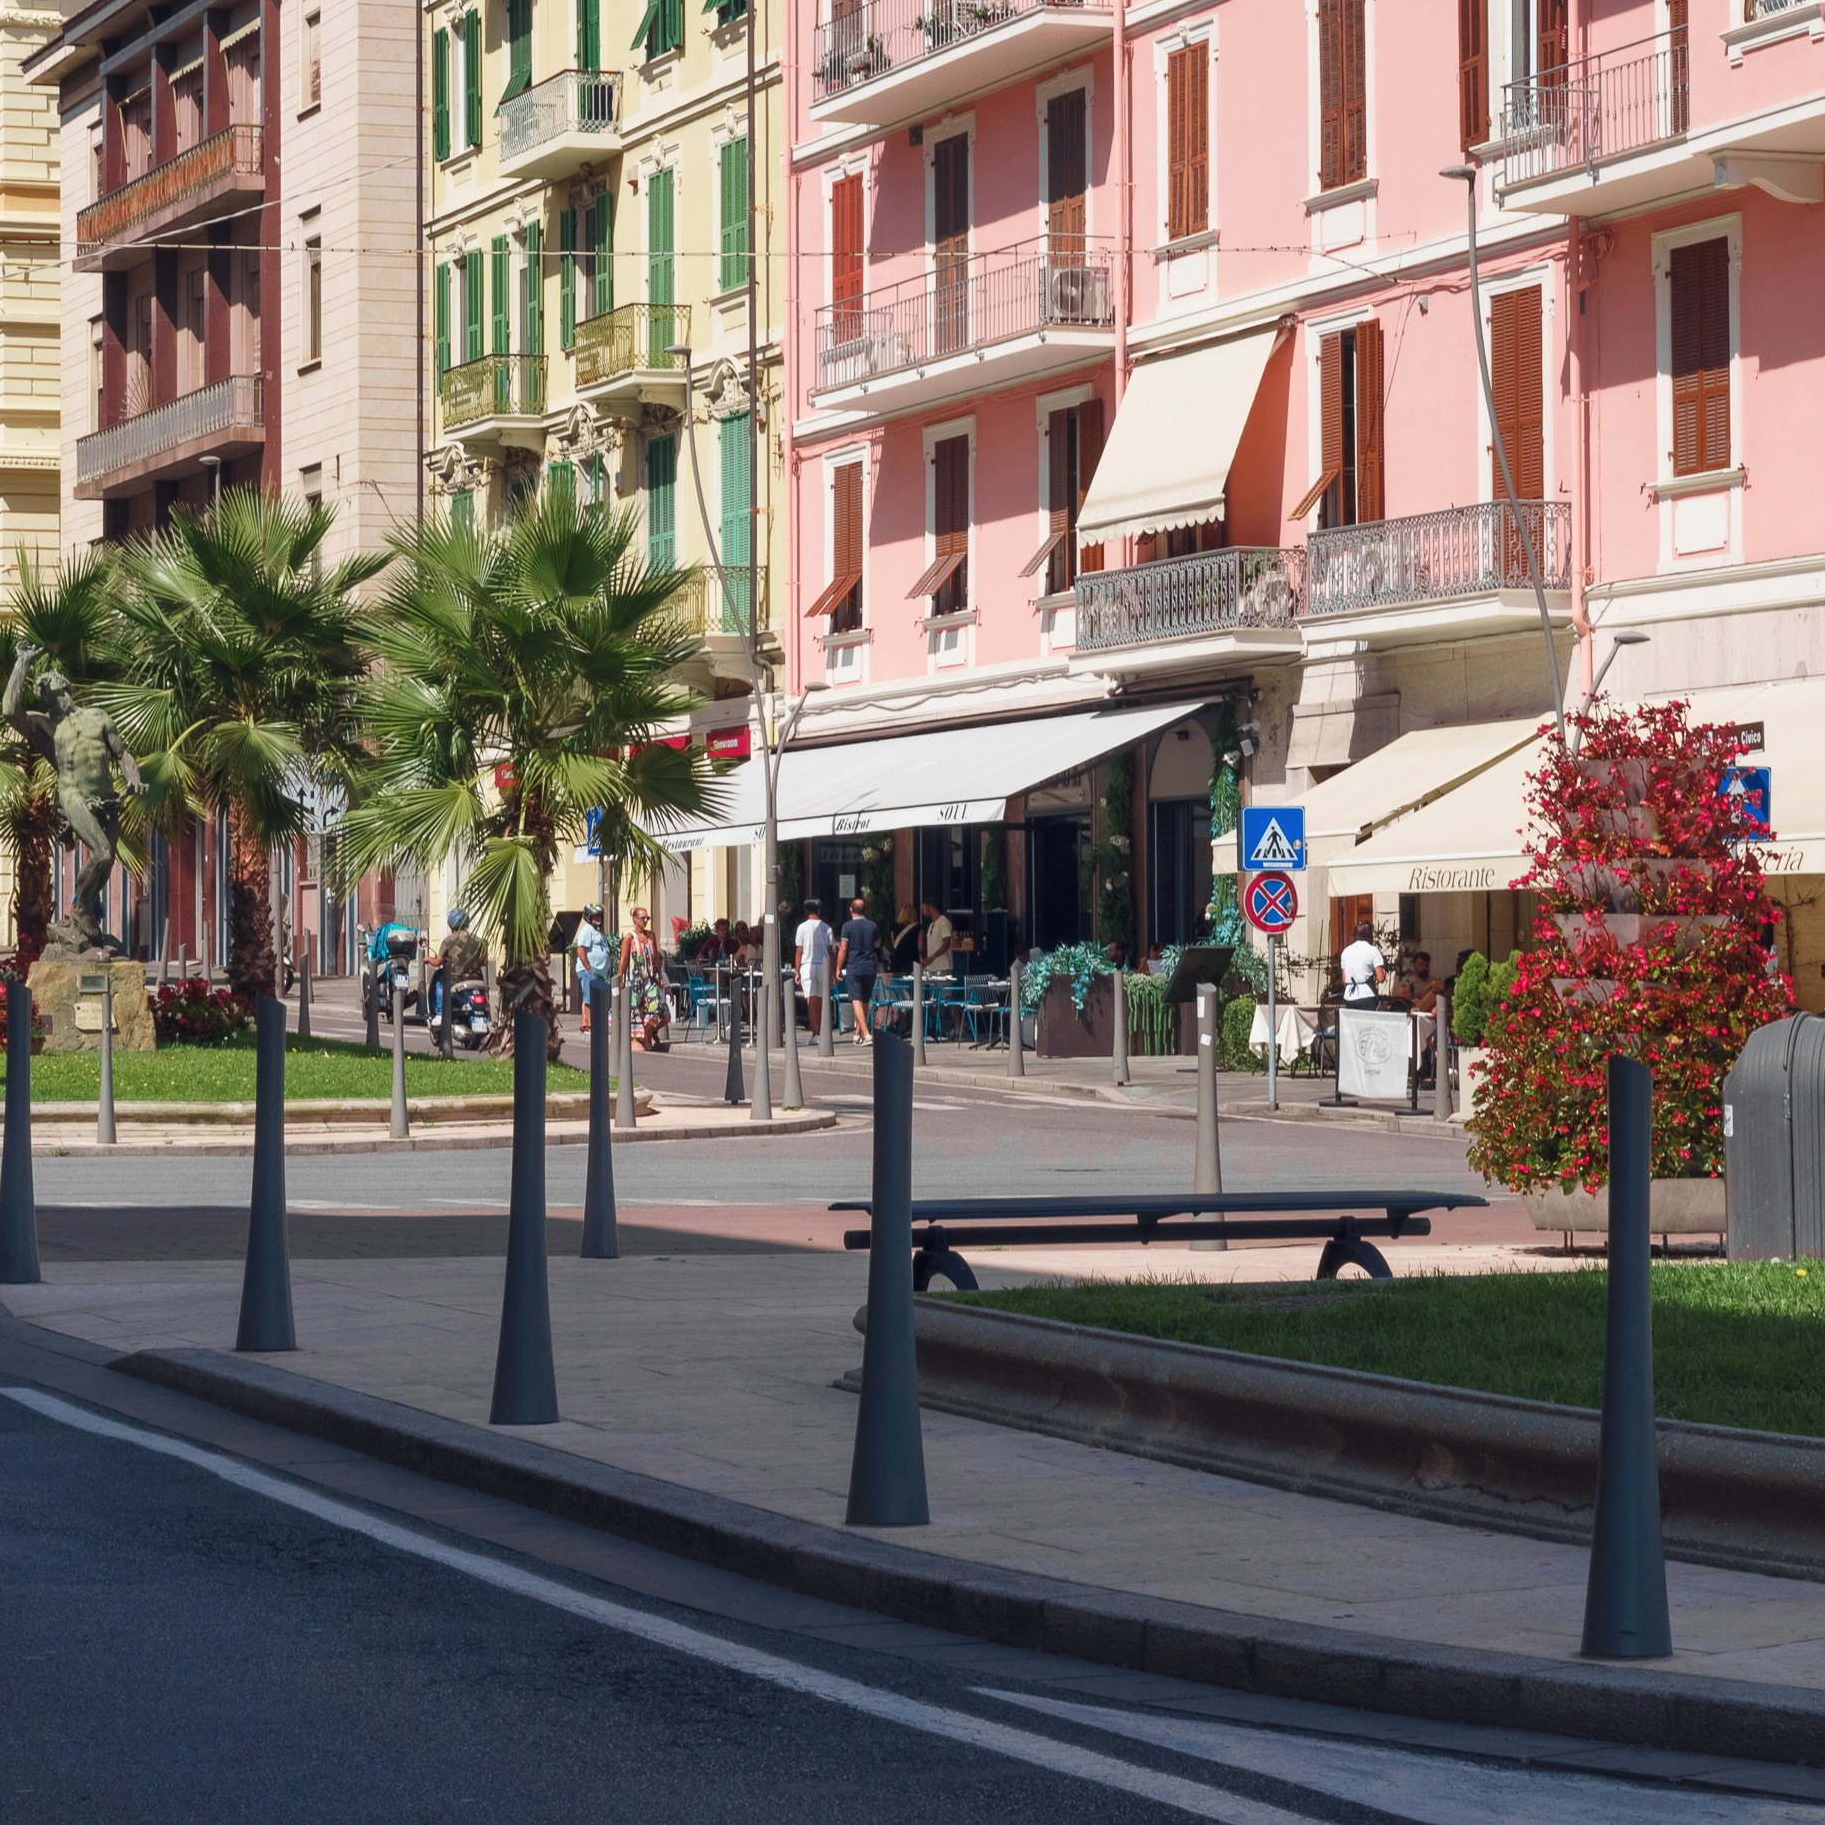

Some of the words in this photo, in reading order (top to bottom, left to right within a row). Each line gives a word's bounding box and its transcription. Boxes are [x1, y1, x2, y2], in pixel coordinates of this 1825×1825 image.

[1741, 729, 1762, 745] Civico
[937, 803, 968, 822] SOUL
[835, 817, 871, 832] Bistrot
[661, 835, 706, 852] Restaurant
[1408, 866, 1495, 890] Ristorante
